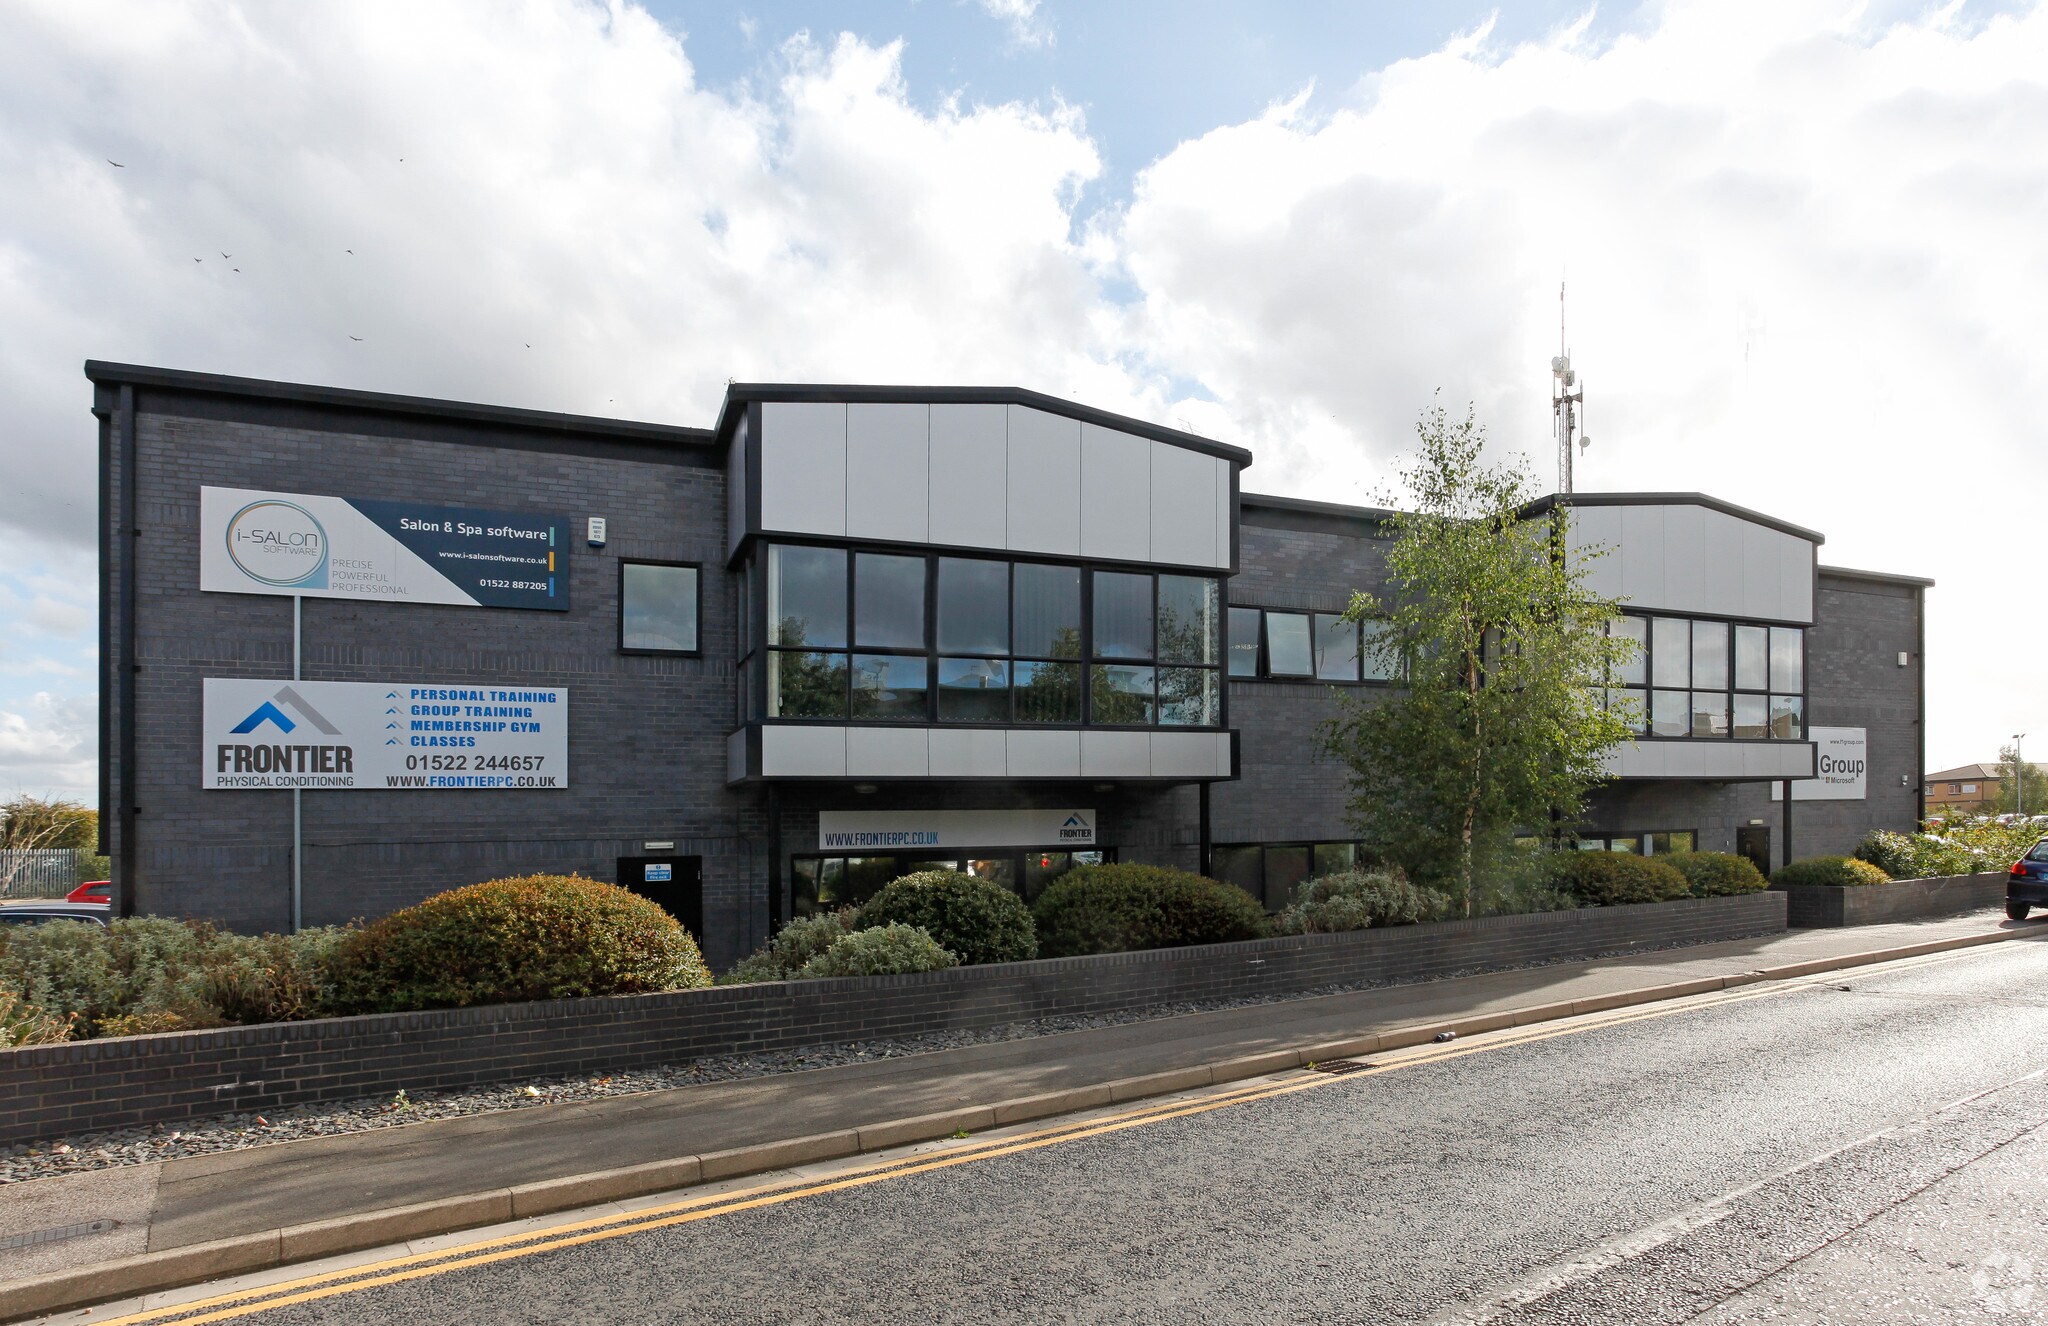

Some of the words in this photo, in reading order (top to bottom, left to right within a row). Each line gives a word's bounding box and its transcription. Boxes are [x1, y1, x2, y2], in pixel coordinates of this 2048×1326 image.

[400, 518, 439, 533] Salon
[444, 521, 453, 533] &
[457, 522, 483, 538] Spa
[487, 523, 547, 541] software
[263, 545, 317, 557] SOFTWARE
[332, 558, 373, 570] PRECISE
[439, 551, 547, 566] www.i-salonsoftware.co.uk
[332, 570, 389, 582] POWERFUL
[332, 582, 408, 595] PROFESSIONAL
[480, 578, 510, 590] 01522
[512, 579, 547, 591] 887205
[411, 689, 486, 702] PERSONAL
[490, 691, 556, 704] TRAINING
[411, 705, 461, 717] GROUP
[464, 706, 532, 718] TRAINING
[411, 721, 506, 732] MEMBERSHIP
[510, 721, 541, 733] GYM
[411, 735, 476, 747] CLASSES
[217, 744, 353, 773] FRONTIER
[406, 754, 467, 771] 01522
[474, 755, 545, 771] 244657
[1820, 755, 1864, 777] Group
[217, 776, 273, 787] PHYSICAL
[275, 776, 353, 787] CONDITIONING
[386, 775, 556, 788] WWW.FRONTIERPC.CO.UK
[825, 831, 938, 846] WWW.FRONTIERPC.CO.UK
[1059, 828, 1092, 838] FRONTIER
